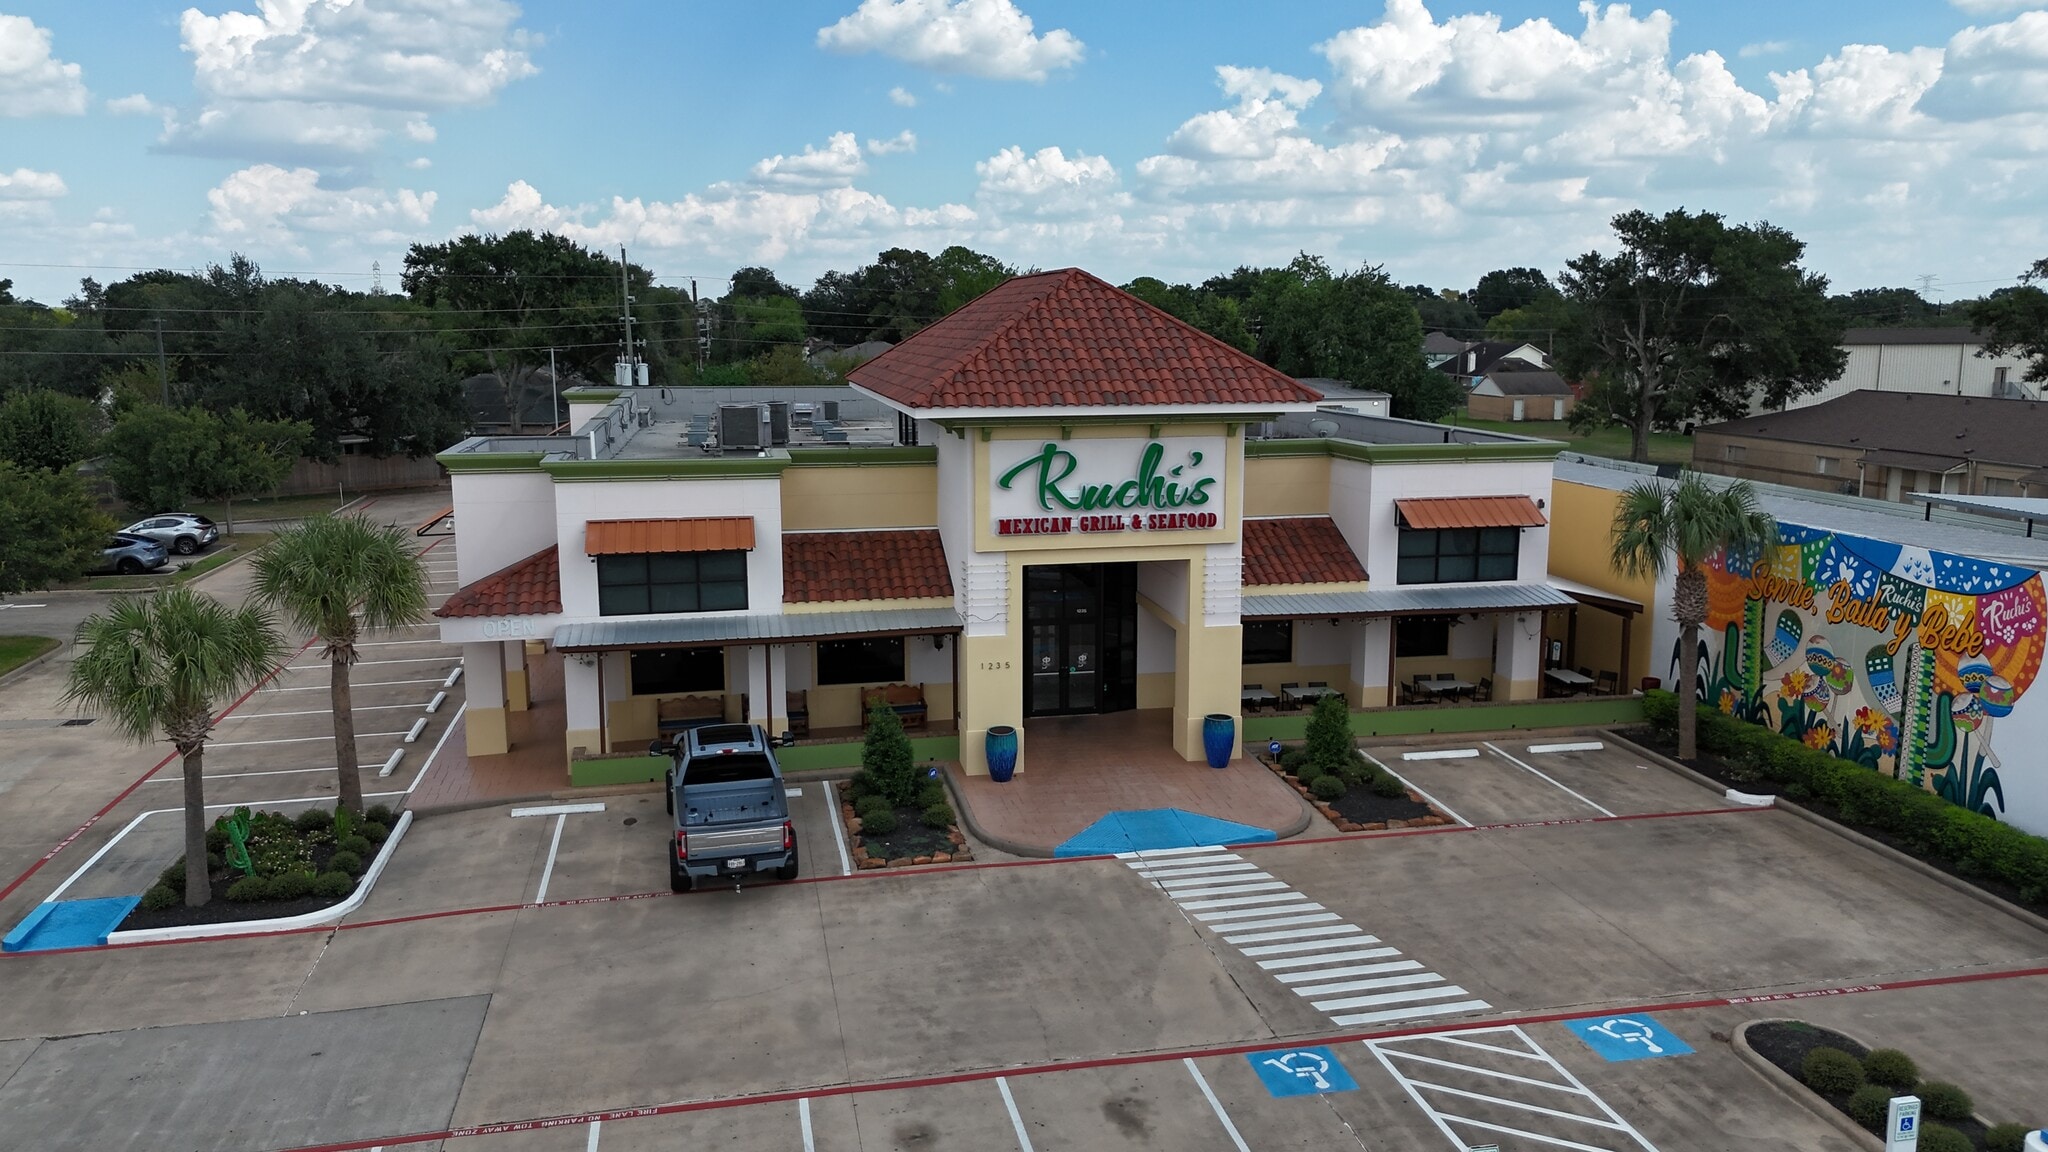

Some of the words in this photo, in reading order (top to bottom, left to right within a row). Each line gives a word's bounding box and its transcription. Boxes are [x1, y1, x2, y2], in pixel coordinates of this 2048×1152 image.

[998, 442, 1216, 511] Ruchi's
[998, 516, 1072, 535] MEXICAN
[1079, 514, 1125, 533] GRILL
[1131, 513, 1143, 530] &
[1148, 511, 1218, 530] SEAFOOD
[1826, 577, 1890, 633] Baila
[1886, 611, 1912, 657] y
[1919, 602, 1984, 658] Bebe
[483, 619, 536, 638] OPEN
[609, 1111, 634, 1120] LANE
[638, 1107, 659, 1116] FIRE
[541, 1117, 584, 1128] PARKING
[587, 1114, 601, 1122] NO
[452, 1129, 478, 1137] ZONE
[482, 1126, 509, 1135] AWAY
